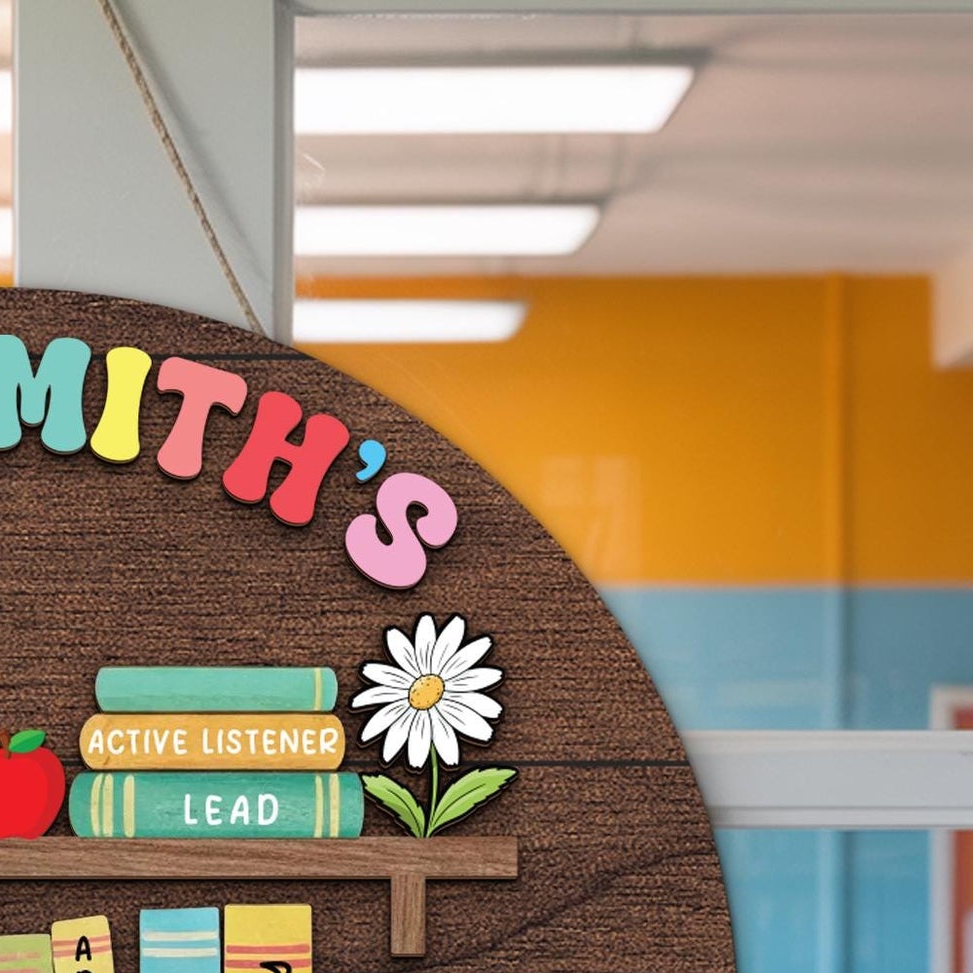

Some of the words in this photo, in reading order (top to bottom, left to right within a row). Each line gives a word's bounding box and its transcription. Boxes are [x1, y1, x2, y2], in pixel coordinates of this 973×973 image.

[87, 727, 188, 756] ACTIVE
[201, 727, 339, 756] LISTENER
[183, 793, 279, 826] LEAD
